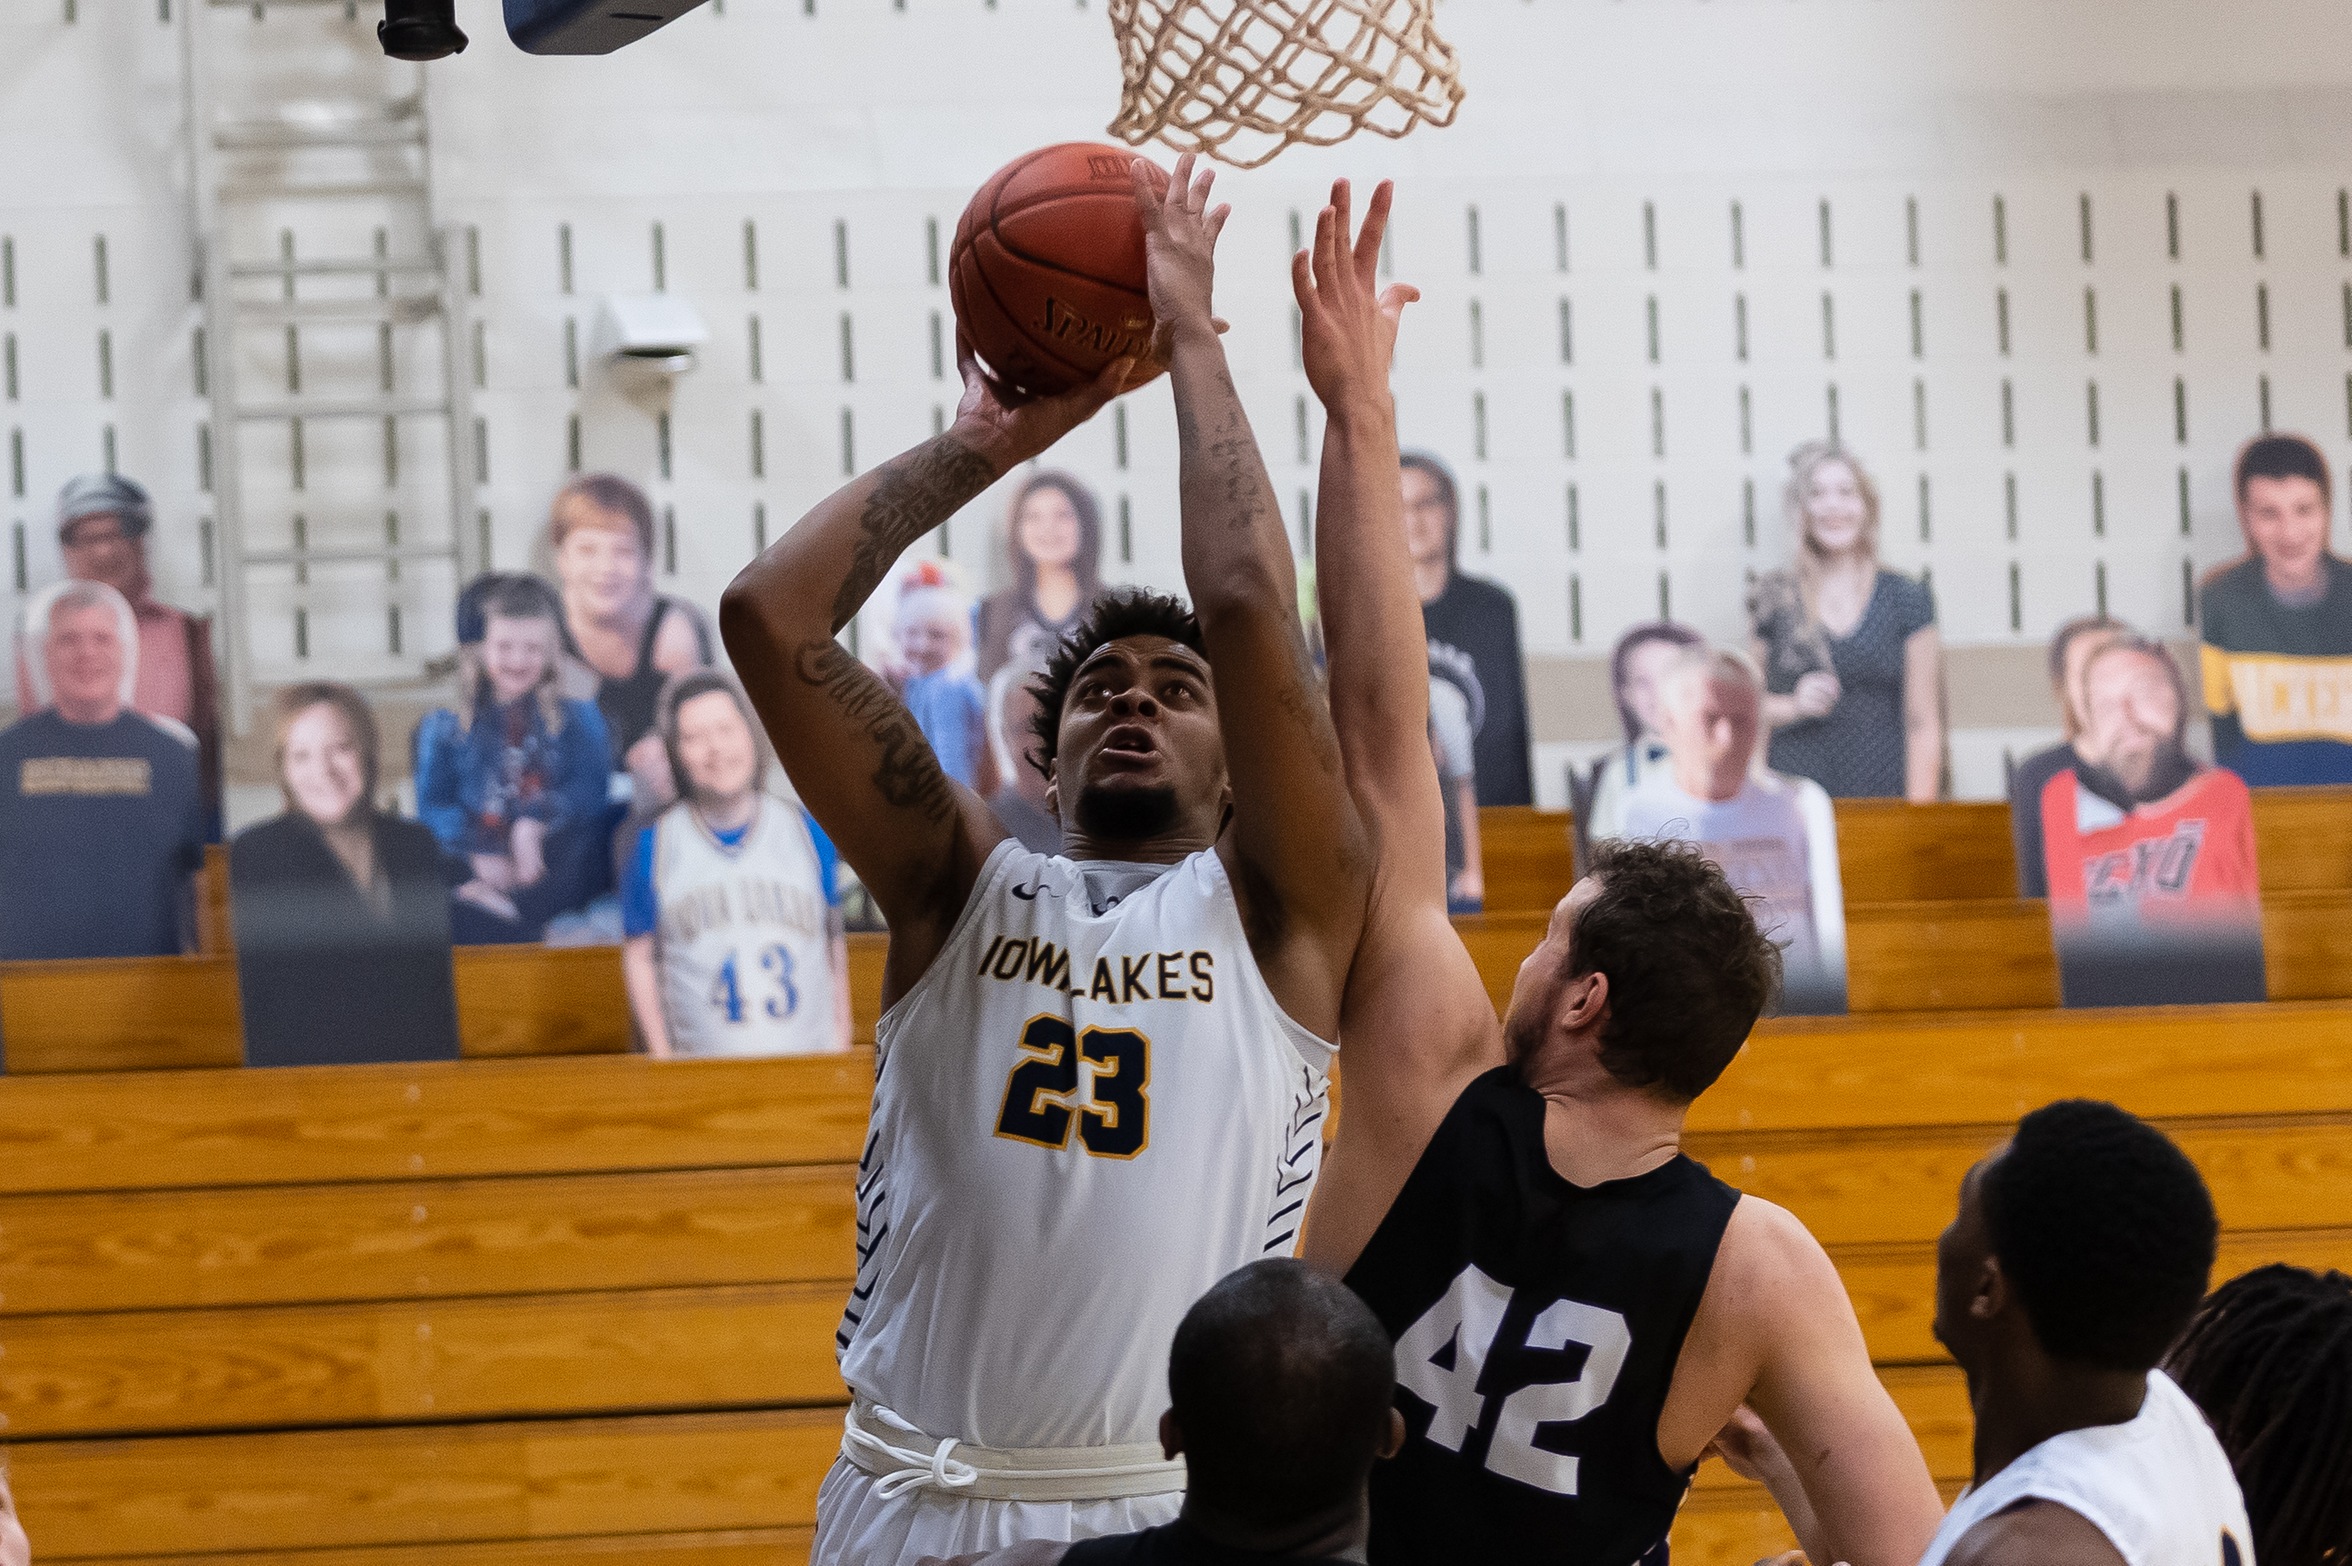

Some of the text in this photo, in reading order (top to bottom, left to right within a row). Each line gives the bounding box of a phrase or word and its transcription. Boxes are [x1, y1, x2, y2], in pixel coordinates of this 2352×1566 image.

[709, 944, 800, 1025] 43
[993, 1011, 1152, 1162] 23
[1393, 1262, 1633, 1497] 42
